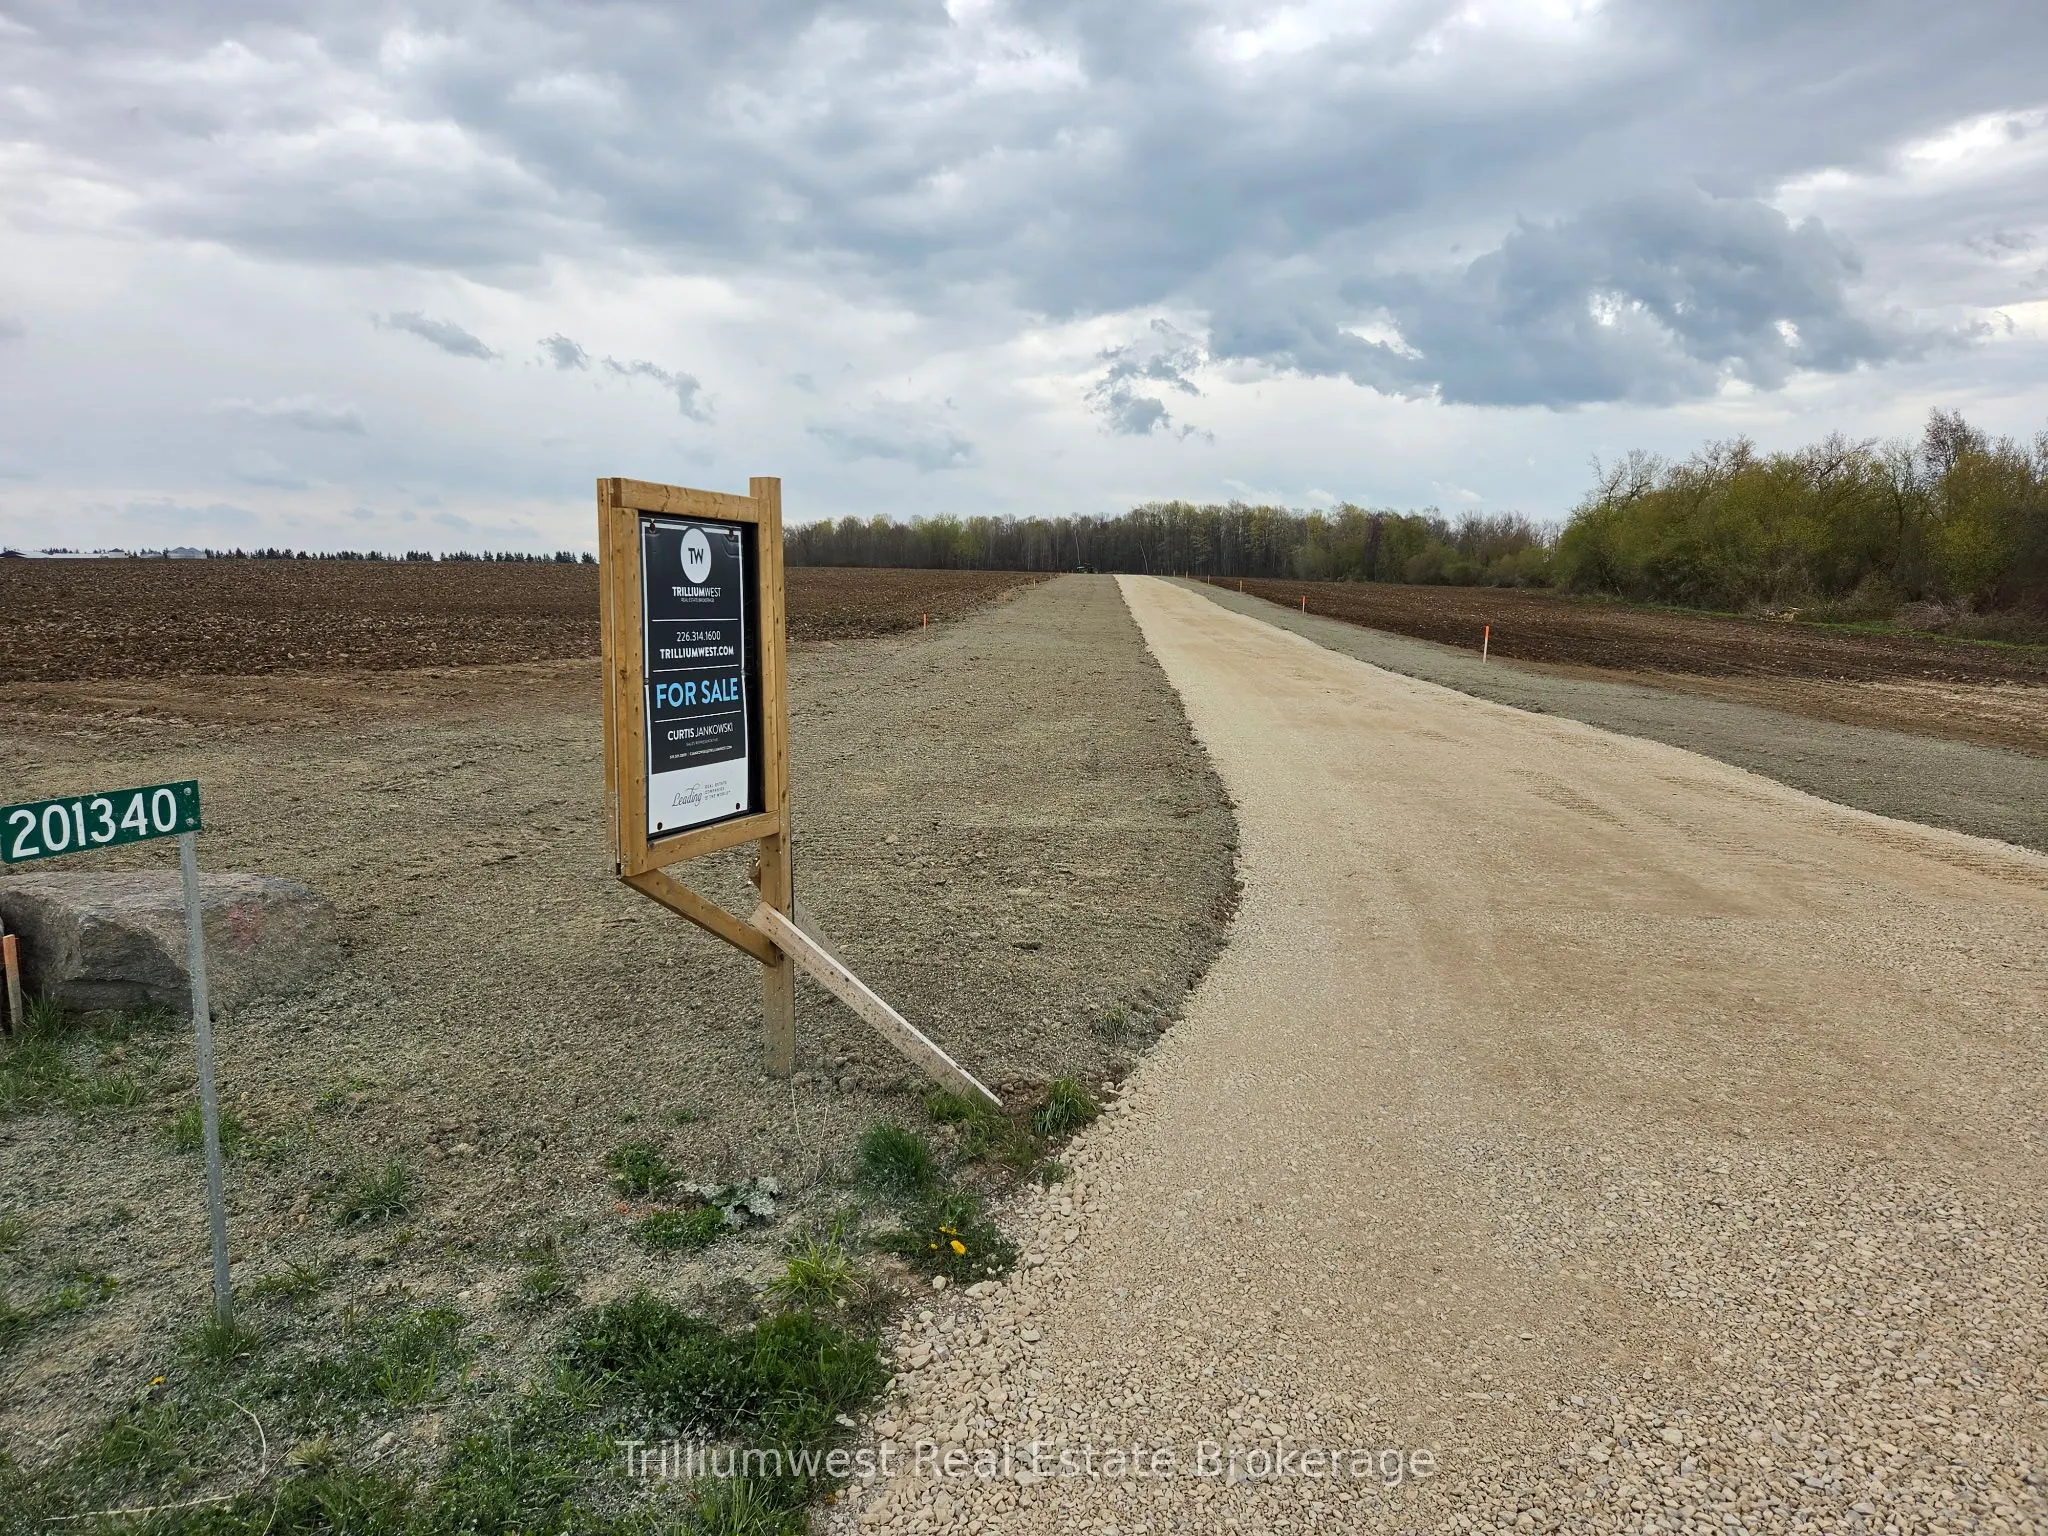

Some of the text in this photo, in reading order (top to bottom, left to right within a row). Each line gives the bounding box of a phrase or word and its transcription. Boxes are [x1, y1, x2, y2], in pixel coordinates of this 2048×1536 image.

[688, 548, 704, 565] TW
[672, 586, 721, 597] TRILLIUMWEST
[676, 631, 721, 642] 226.314.1600
[659, 646, 734, 659] TRILLIUMWEST.COM
[656, 677, 739, 709] FOR SALE
[667, 722, 734, 741] CURTIS JANKOWSKI
[672, 783, 703, 807] Leading
[8, 788, 177, 859] 201340
